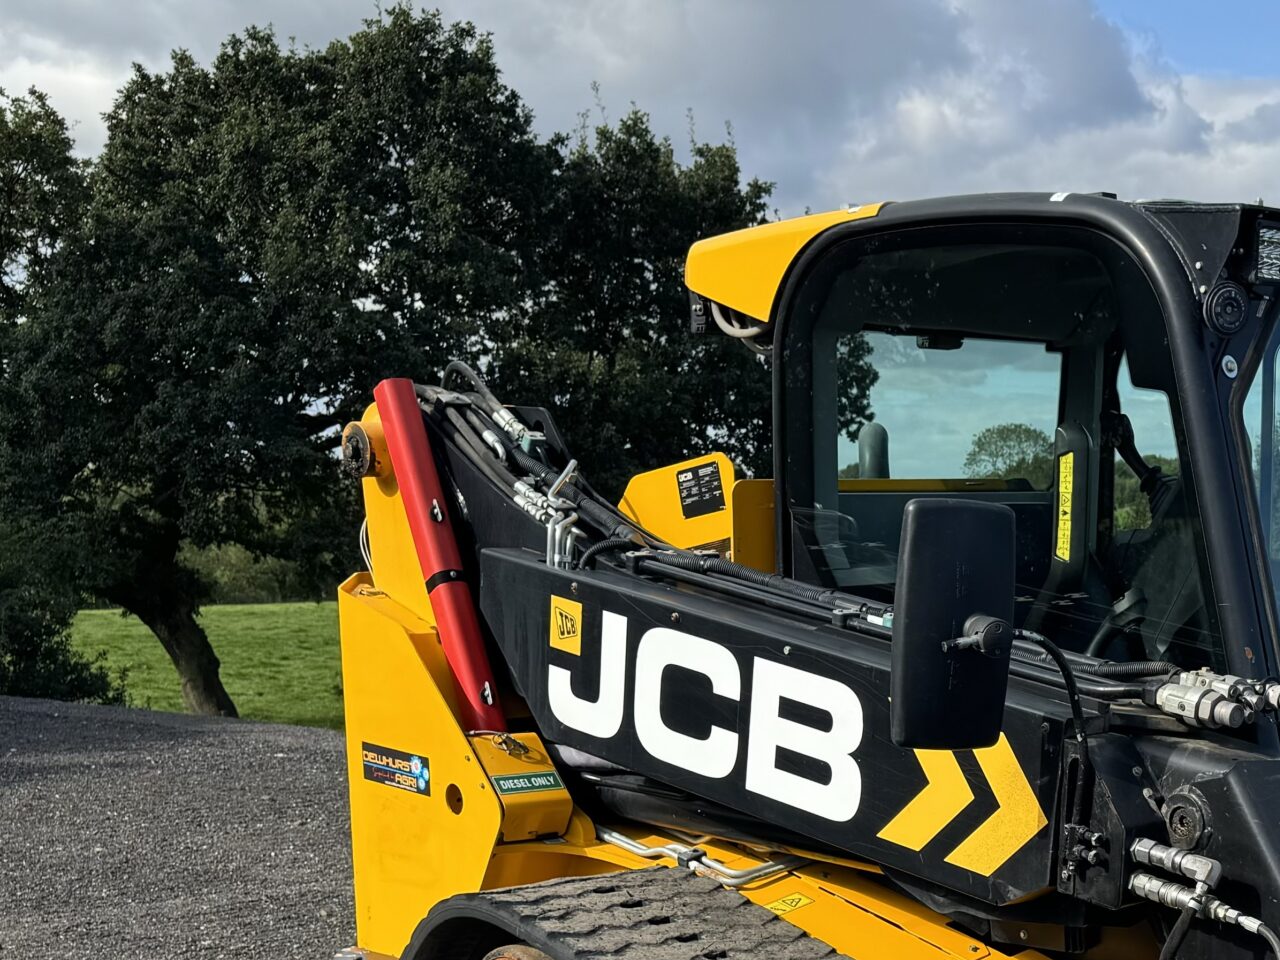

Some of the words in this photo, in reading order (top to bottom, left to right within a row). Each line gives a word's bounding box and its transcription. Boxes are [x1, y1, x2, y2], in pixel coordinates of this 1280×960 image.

[558, 611, 576, 636] JCB
[548, 610, 864, 822] JCB
[395, 773, 417, 788] AGRI
[499, 778, 532, 790] DIESEL
[531, 776, 555, 787] ONLY
